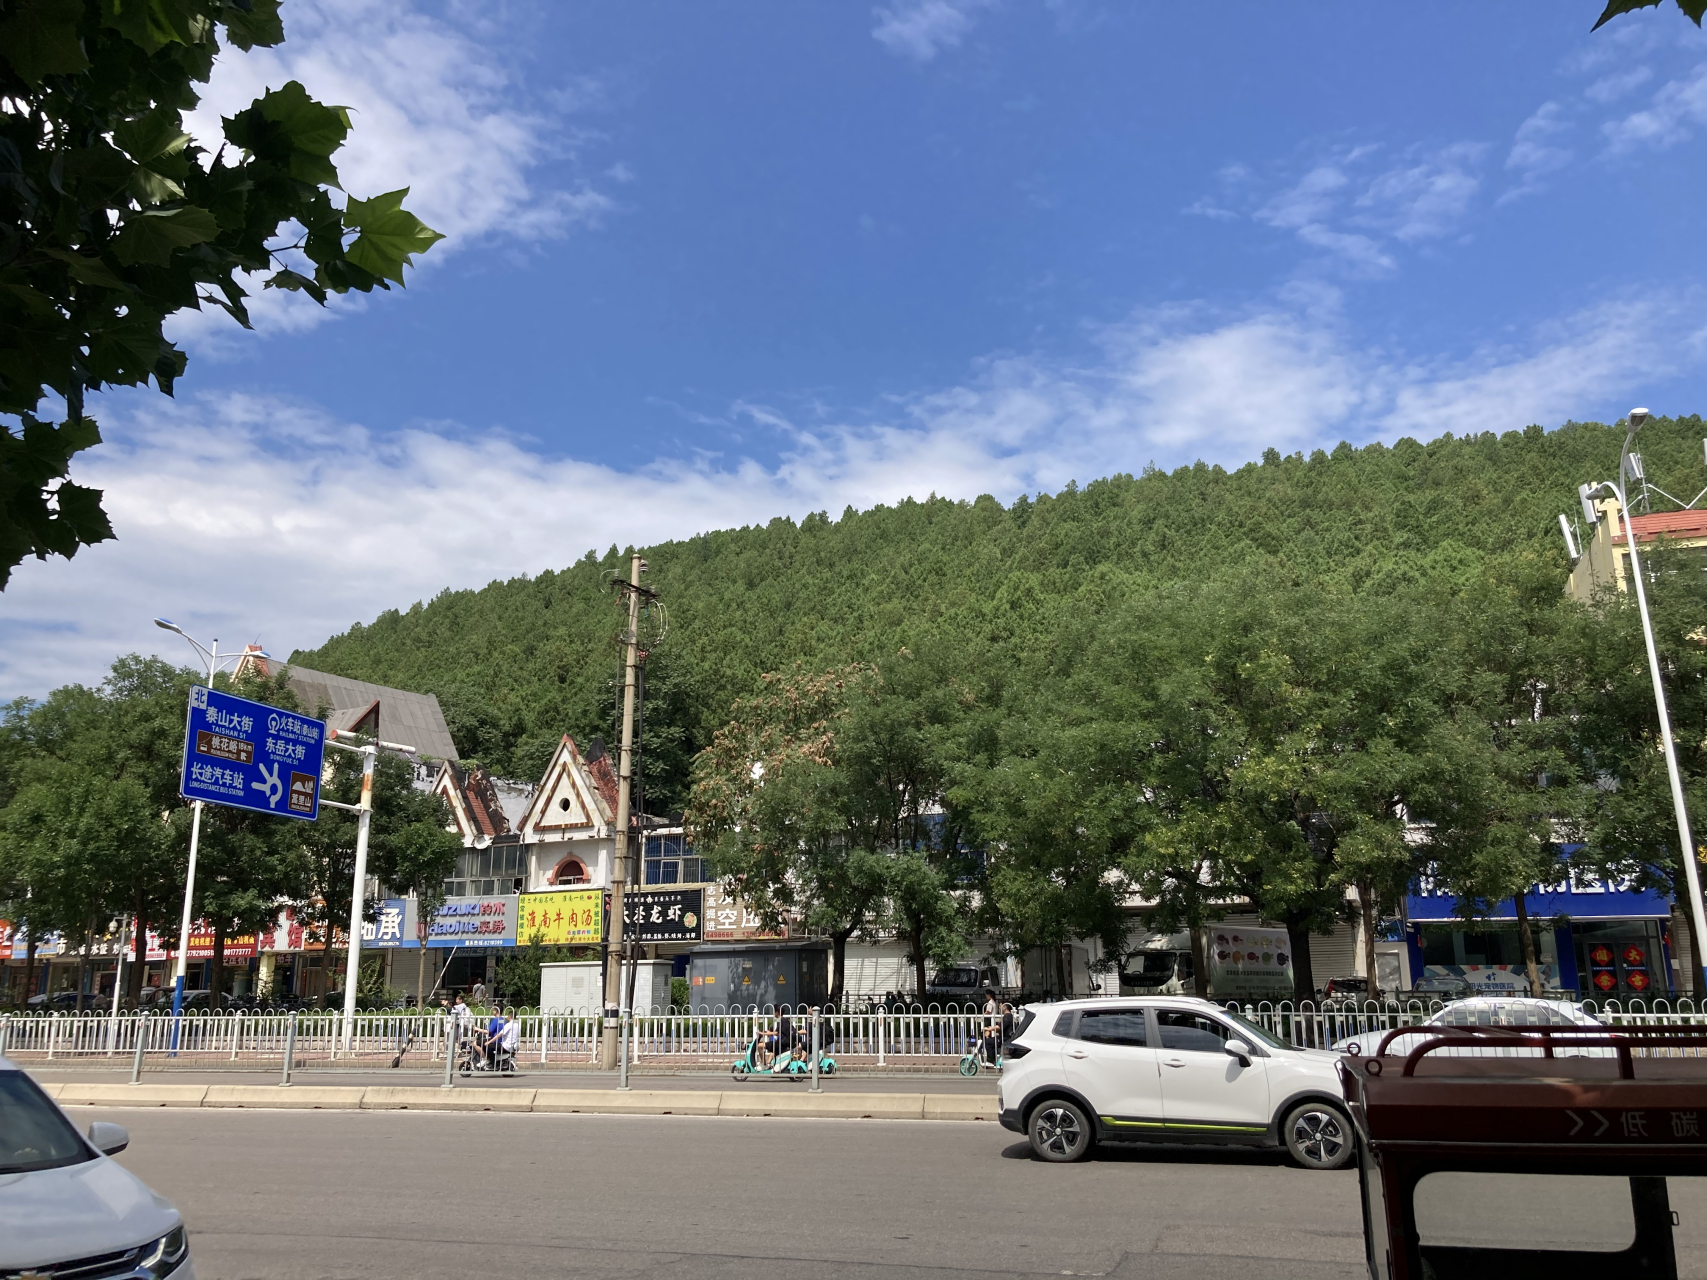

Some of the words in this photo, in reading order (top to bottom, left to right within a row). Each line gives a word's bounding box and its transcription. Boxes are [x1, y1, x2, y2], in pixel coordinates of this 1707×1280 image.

[194, 688, 205, 704] 北
[206, 706, 253, 733] 泰山大街
[212, 725, 239, 738] TAISHAN
[239, 731, 247, 740] St
[298, 735, 316, 744] STATION
[212, 736, 238, 753] 桃花峪
[265, 737, 305, 760] 东岳大街
[270, 753, 293, 764] DONGYUE
[191, 761, 244, 789] 长途汽车站
[228, 788, 245, 797] STATION
[706, 886, 716, 931] 志高掘进
[526, 908, 592, 930] 淮南牛肉汤
[1620, 1111, 1700, 1137] 低碳
